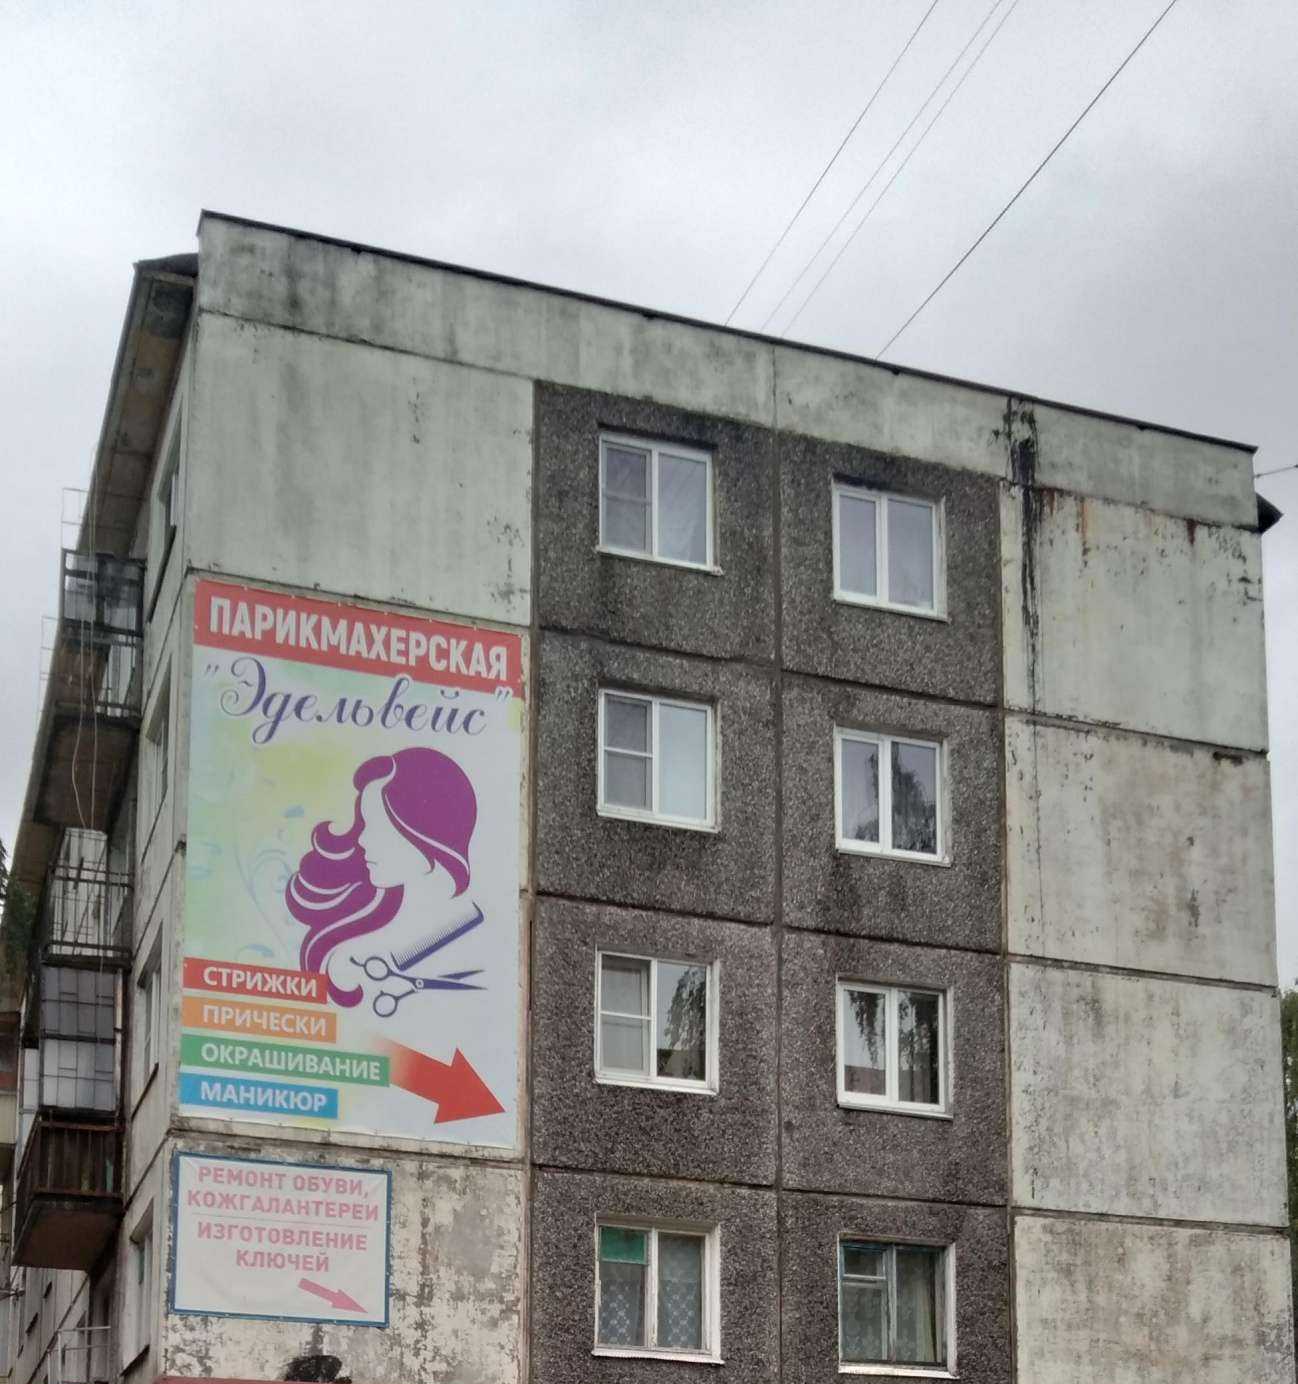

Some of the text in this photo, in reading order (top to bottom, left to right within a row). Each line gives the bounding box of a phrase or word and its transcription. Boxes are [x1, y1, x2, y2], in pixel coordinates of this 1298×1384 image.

[208, 596, 508, 681] ПАРИКМАХЕРСКАЯ
[203, 966, 318, 998] СТРИЖКИ
[202, 1004, 327, 1037] ПРИЧЕСКИ
[201, 1043, 381, 1081] ОКРАШИВАНИЕ
[200, 1081, 327, 1111] МАНИКЮР
[198, 1166, 370, 1199] РЕМОНТ ОБУВИ,
[197, 1221, 368, 1251] ИЗГОТОВЛЕНИЕ
[236, 1248, 330, 1272] КЛЮЧЕЙ
